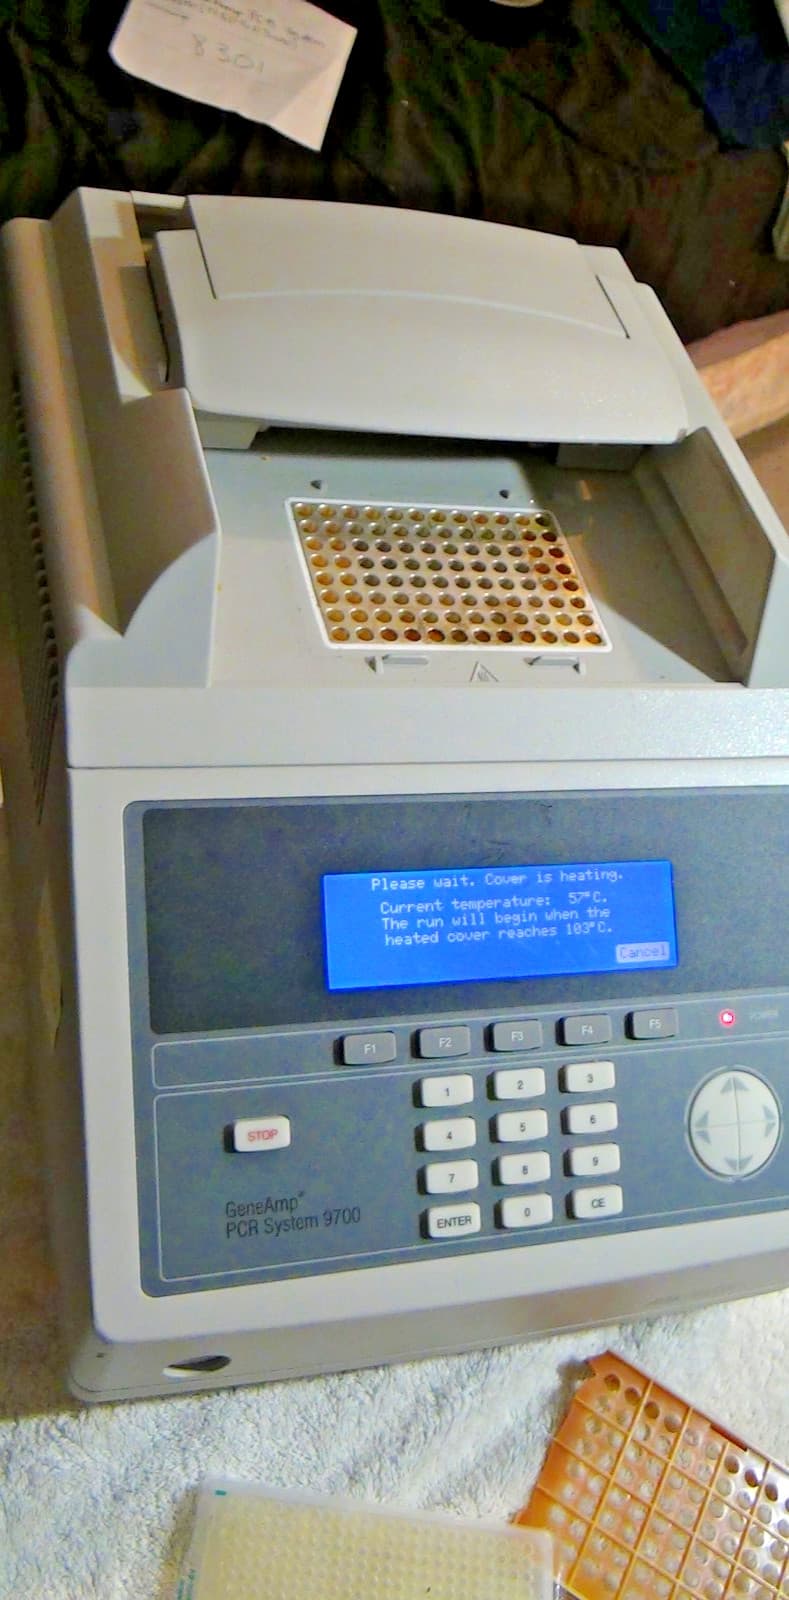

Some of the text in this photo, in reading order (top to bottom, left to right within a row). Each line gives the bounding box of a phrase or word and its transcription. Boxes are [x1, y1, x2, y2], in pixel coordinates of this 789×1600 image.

[371, 868, 623, 891] Please wait. Cover is heating.
[380, 899, 444, 914] Current
[451, 895, 551, 912] temperature:
[382, 906, 611, 931] The run will begin when the
[384, 931, 439, 946] heated
[447, 930, 490, 943] cover
[498, 925, 557, 939] reaches
[619, 943, 667, 960] Cancel
[581, 1023, 595, 1036] F4
[648, 1018, 662, 1030] F5
[511, 1030, 524, 1042] F3
[363, 1042, 377, 1055] F1
[438, 1036, 452, 1049] F2
[586, 1074, 594, 1084] 3
[517, 1080, 524, 1091] 2
[444, 1087, 451, 1098] 1
[589, 1115, 597, 1125] 6
[519, 1122, 527, 1134] 5
[247, 1128, 279, 1142] STOP
[445, 1130, 453, 1142] 4
[591, 1156, 600, 1167] 9
[521, 1165, 529, 1176] 8
[448, 1173, 456, 1184] 7
[591, 1198, 605, 1209] CE
[523, 1207, 532, 1219] 0
[226, 1206, 361, 1239] PCR System 9700
[437, 1215, 472, 1229] ENTER
